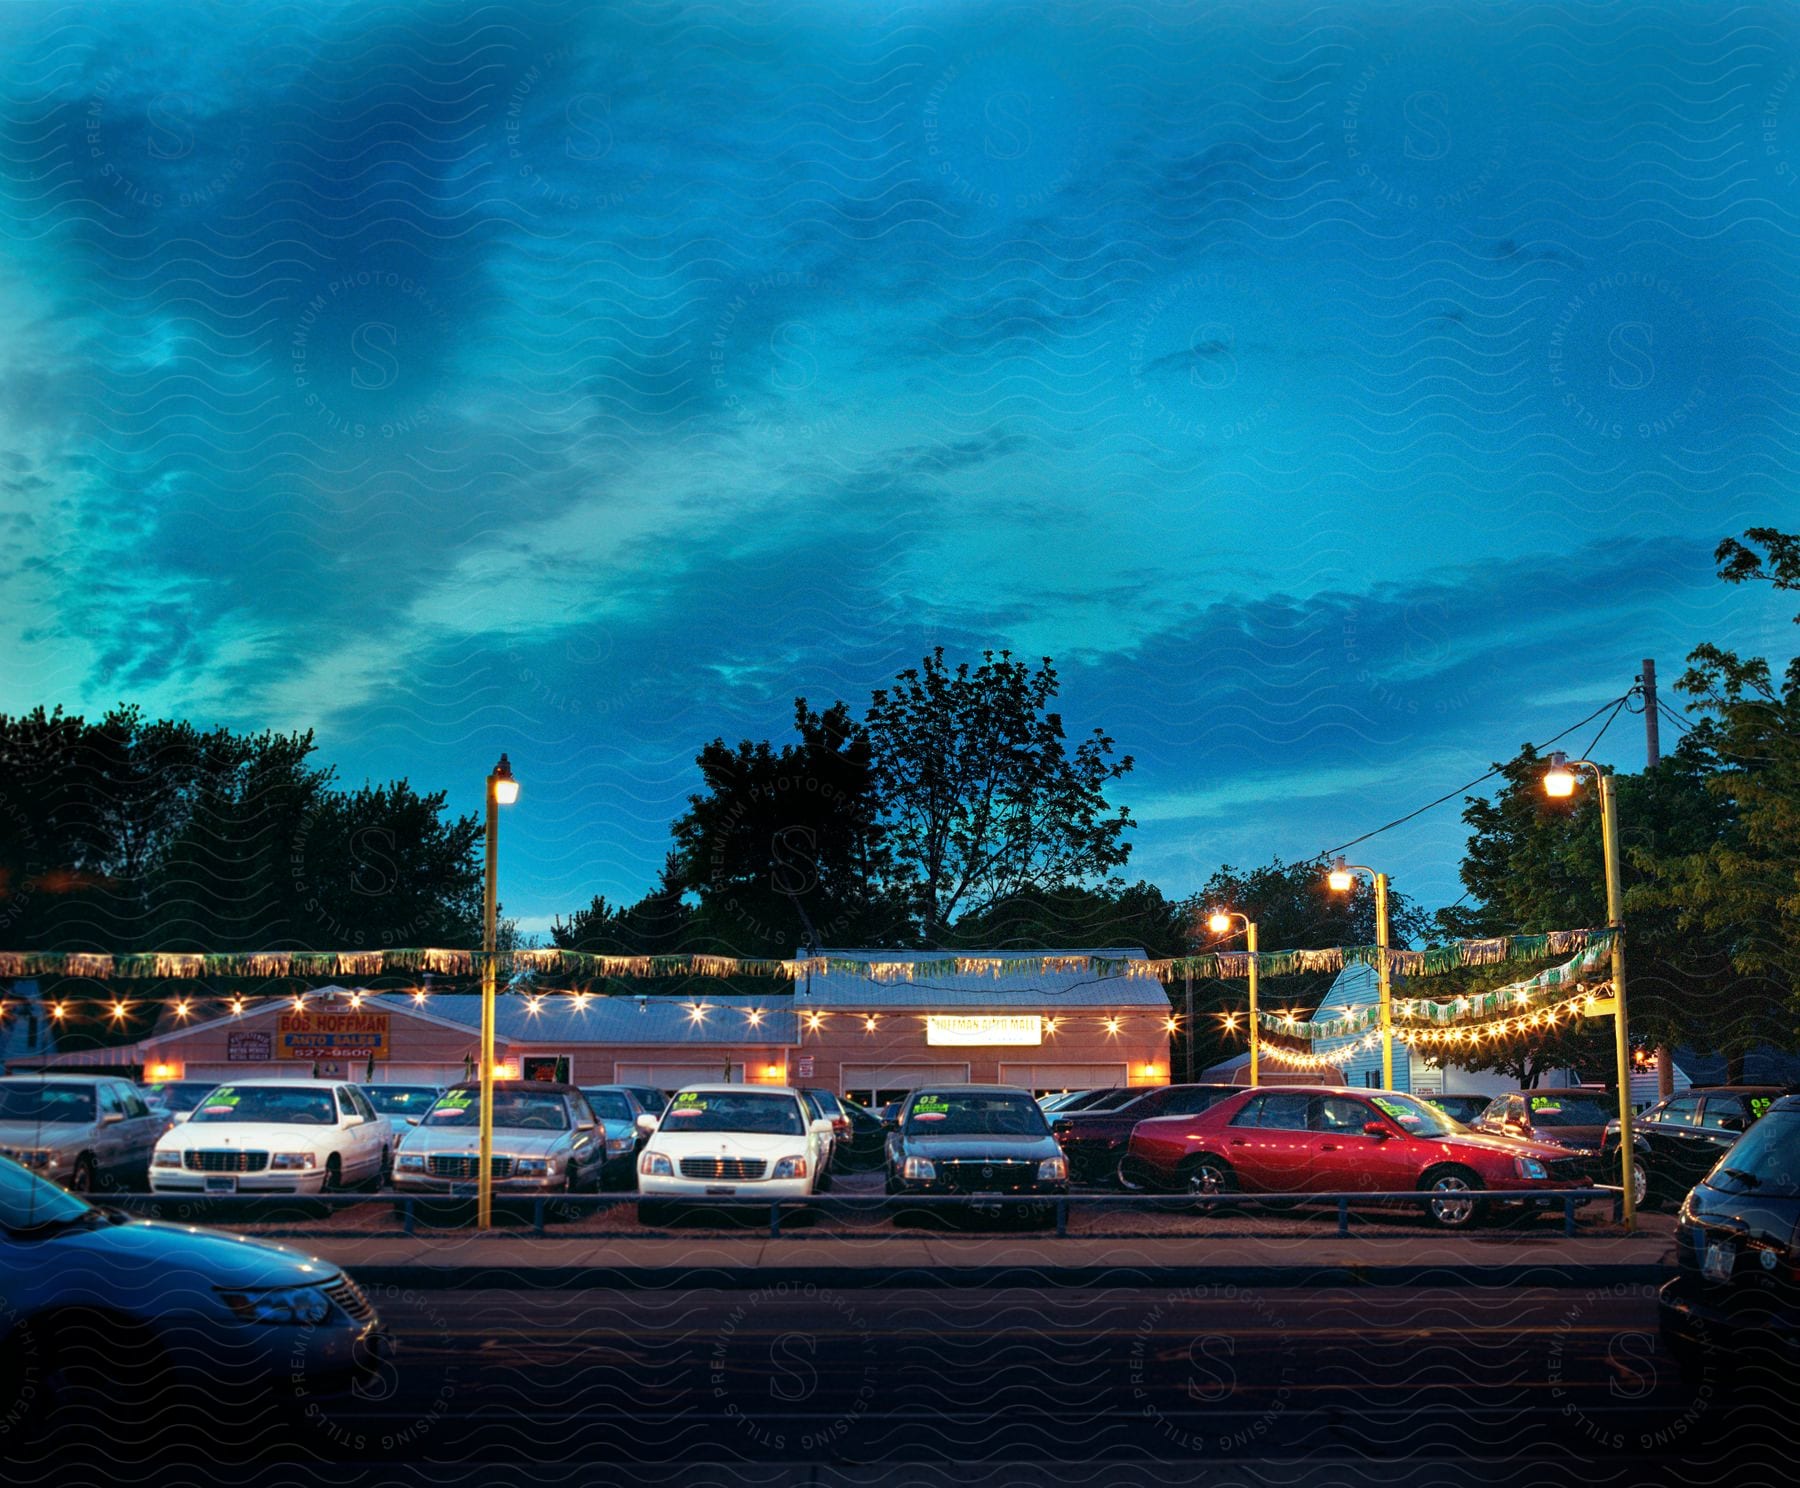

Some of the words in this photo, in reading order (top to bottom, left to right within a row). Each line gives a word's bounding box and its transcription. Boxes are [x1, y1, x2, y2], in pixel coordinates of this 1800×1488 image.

[281, 1016, 310, 1031] BOB
[317, 1016, 386, 1031] HOFFMAN
[291, 1035, 327, 1045] AUTO
[333, 1035, 375, 1045] SALES
[294, 1049, 372, 1057] 527-9500
[1750, 1097, 1771, 1108] 05
